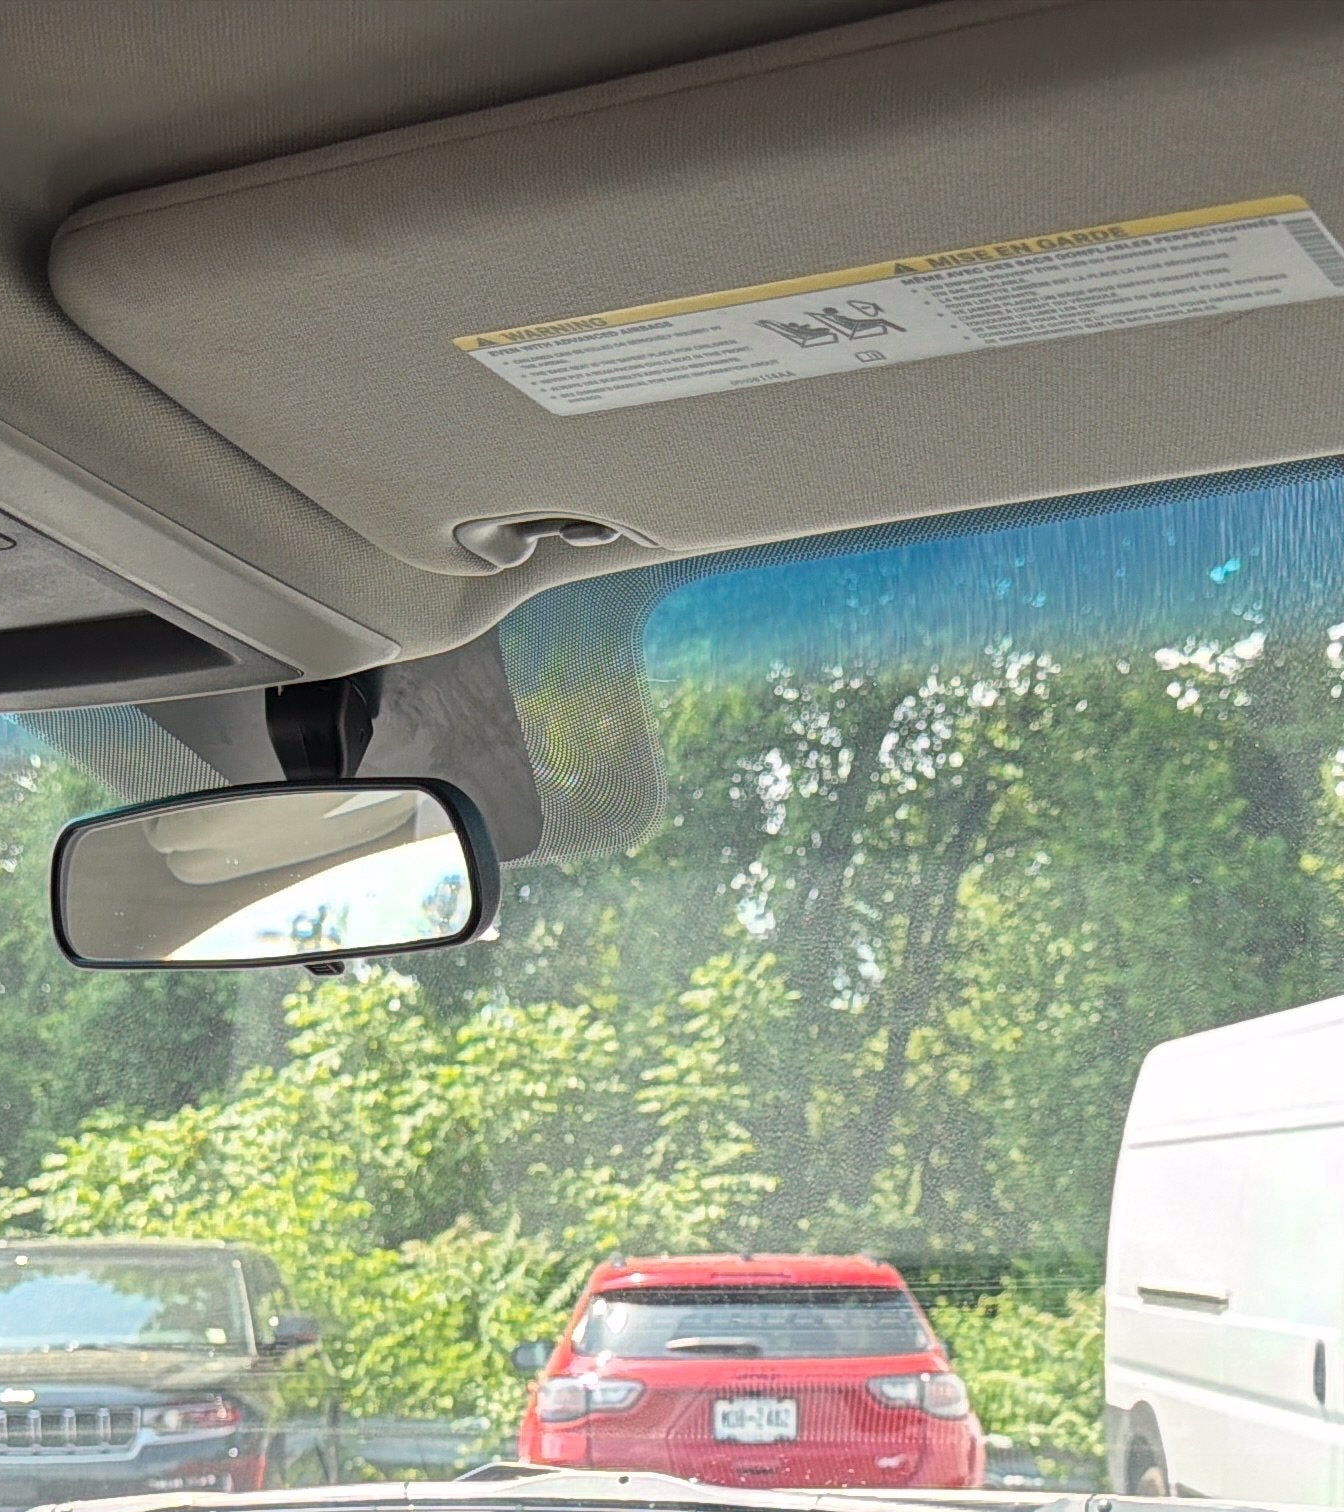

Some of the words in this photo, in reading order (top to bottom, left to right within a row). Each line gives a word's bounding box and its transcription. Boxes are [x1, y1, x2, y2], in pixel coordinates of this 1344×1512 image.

[924, 249, 995, 268] MISE
[993, 242, 1035, 256] EN
[1033, 226, 1128, 249] GARDE
[944, 266, 986, 279] AVEC
[982, 261, 1016, 273] DES
[1013, 254, 1056, 267] SACS
[487, 347, 522, 357] EVEN
[519, 342, 555, 351] WITH
[552, 331, 621, 346] ADVANCED
[618, 321, 674, 334] AIRBAGS
[499, 316, 611, 342] WARNING
